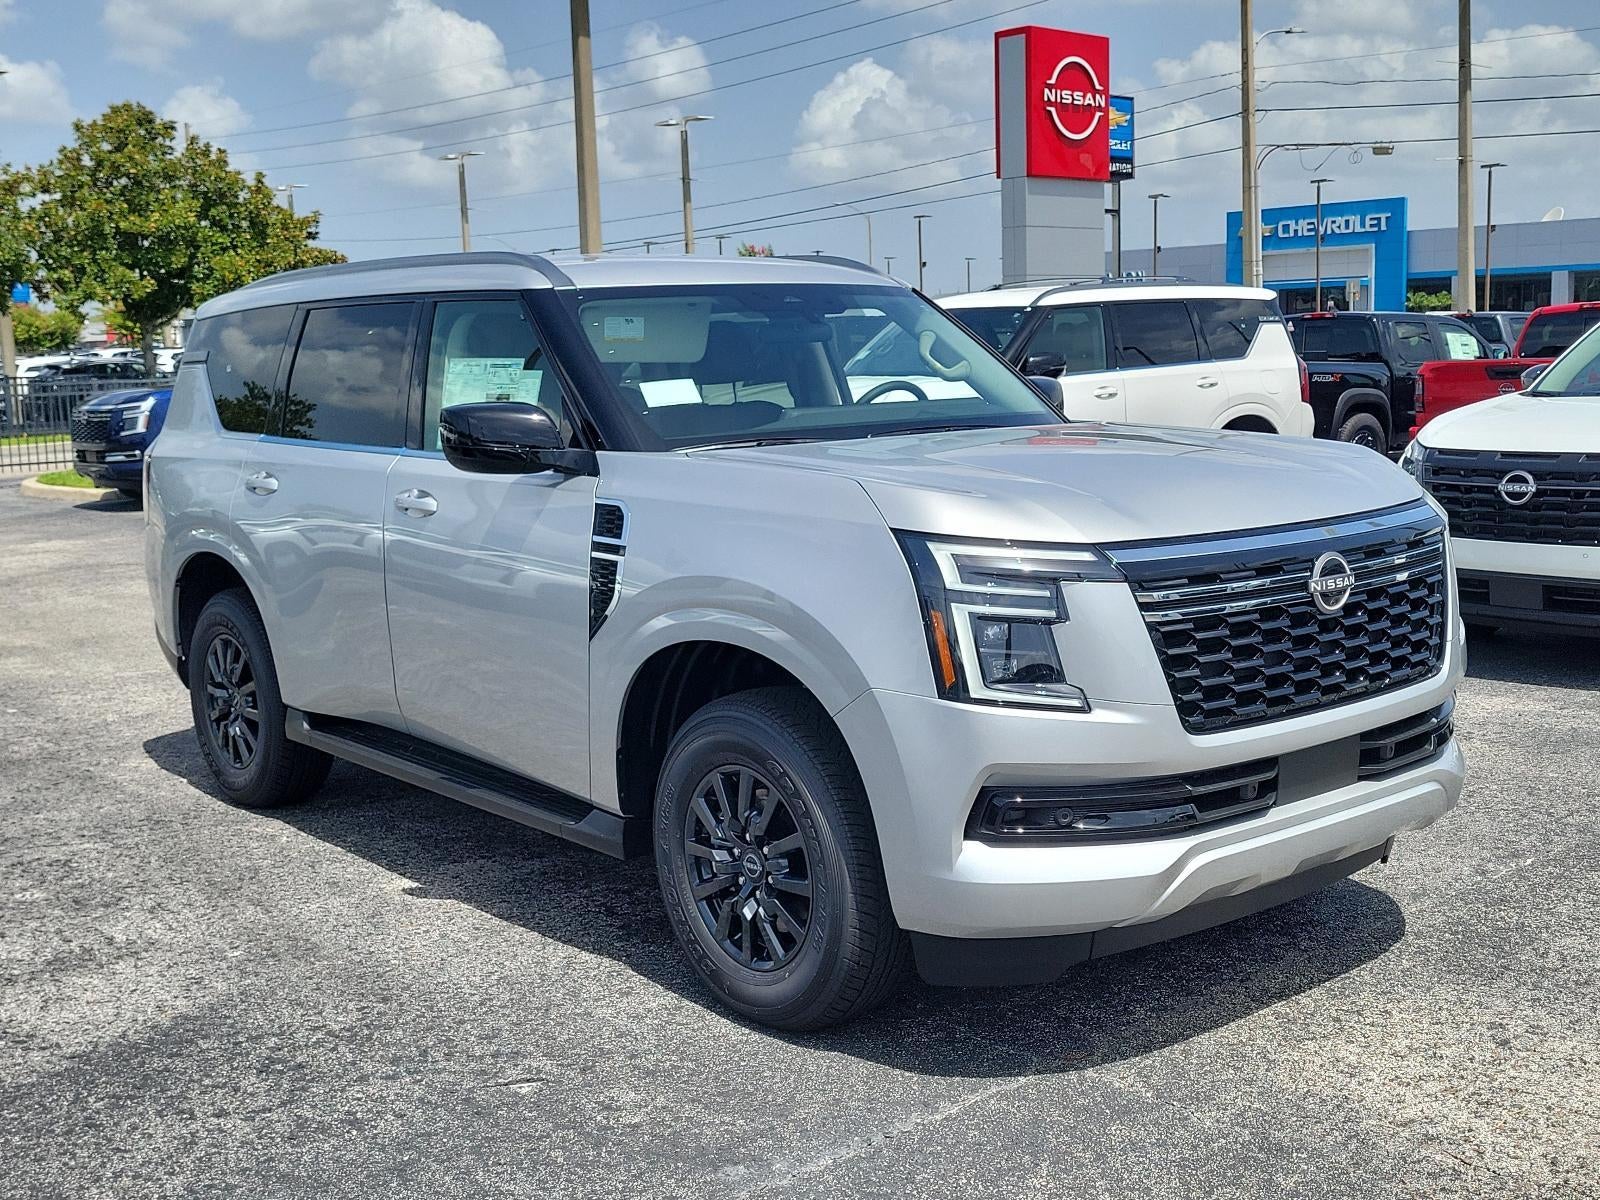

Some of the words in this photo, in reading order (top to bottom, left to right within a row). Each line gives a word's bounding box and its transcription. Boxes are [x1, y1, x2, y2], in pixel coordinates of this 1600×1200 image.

[1044, 87, 1106, 108] NISSAN
[1277, 212, 1391, 238] CHEVROLET
[1498, 483, 1537, 492] NISSAN
[1310, 574, 1355, 592] NISSAN
